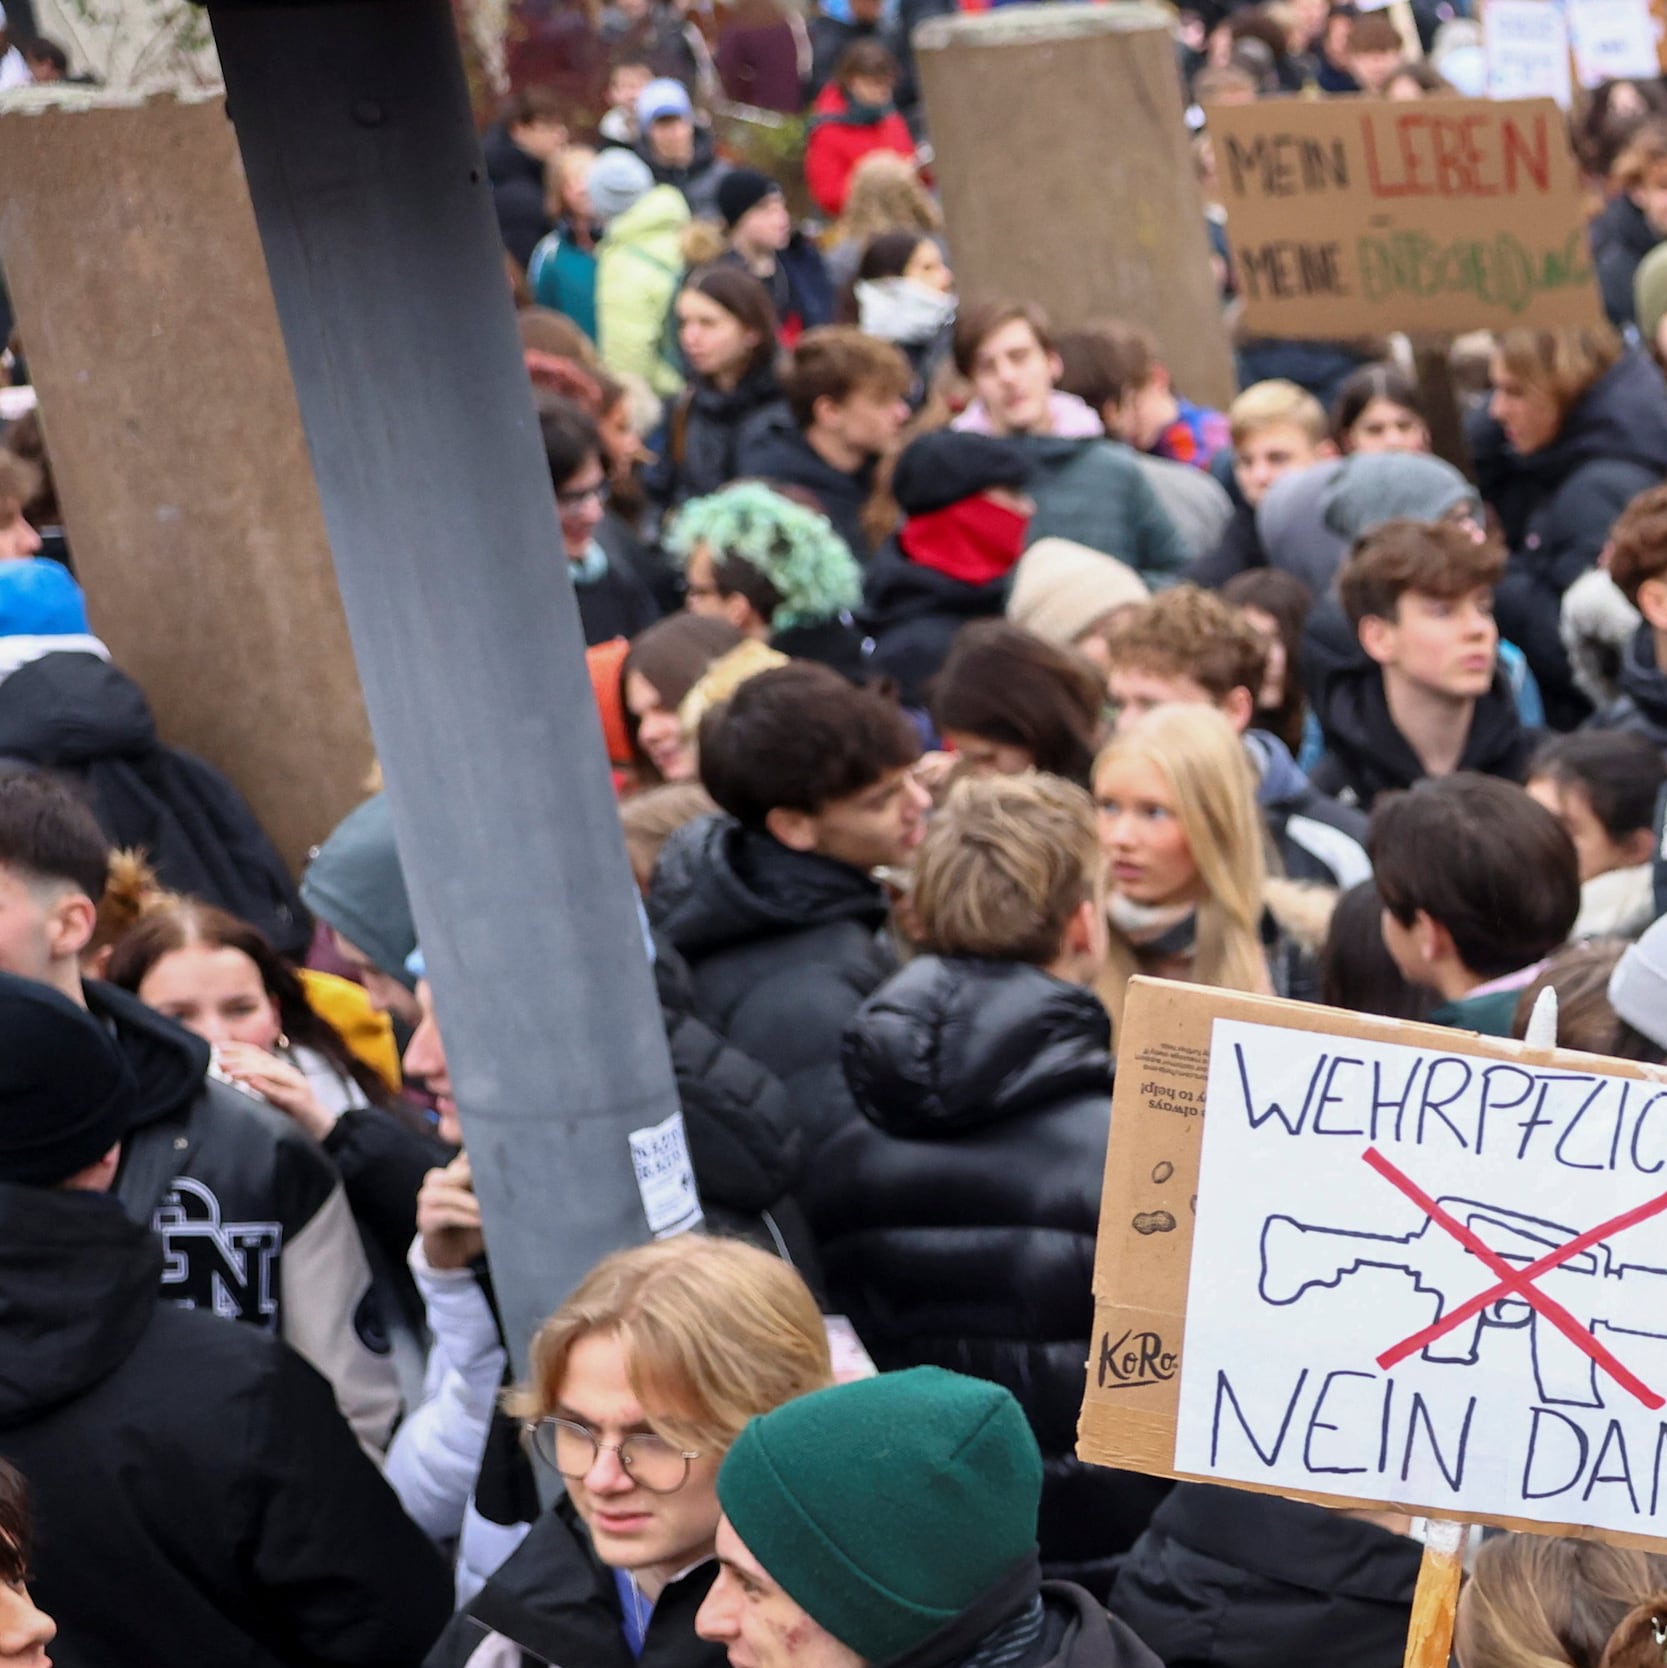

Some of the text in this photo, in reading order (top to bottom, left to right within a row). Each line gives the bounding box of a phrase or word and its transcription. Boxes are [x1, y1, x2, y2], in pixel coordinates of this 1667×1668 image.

[1224, 112, 1552, 199] MEIN LEBEN
[1239, 240, 1345, 298] MEINE
[1140, 1081, 1176, 1100] help!
[1148, 1098, 1198, 1118] always
[1178, 1090, 1193, 1102] to
[1098, 1329, 1178, 1389] KoRo
[1210, 1368, 1476, 1491] NEIN
